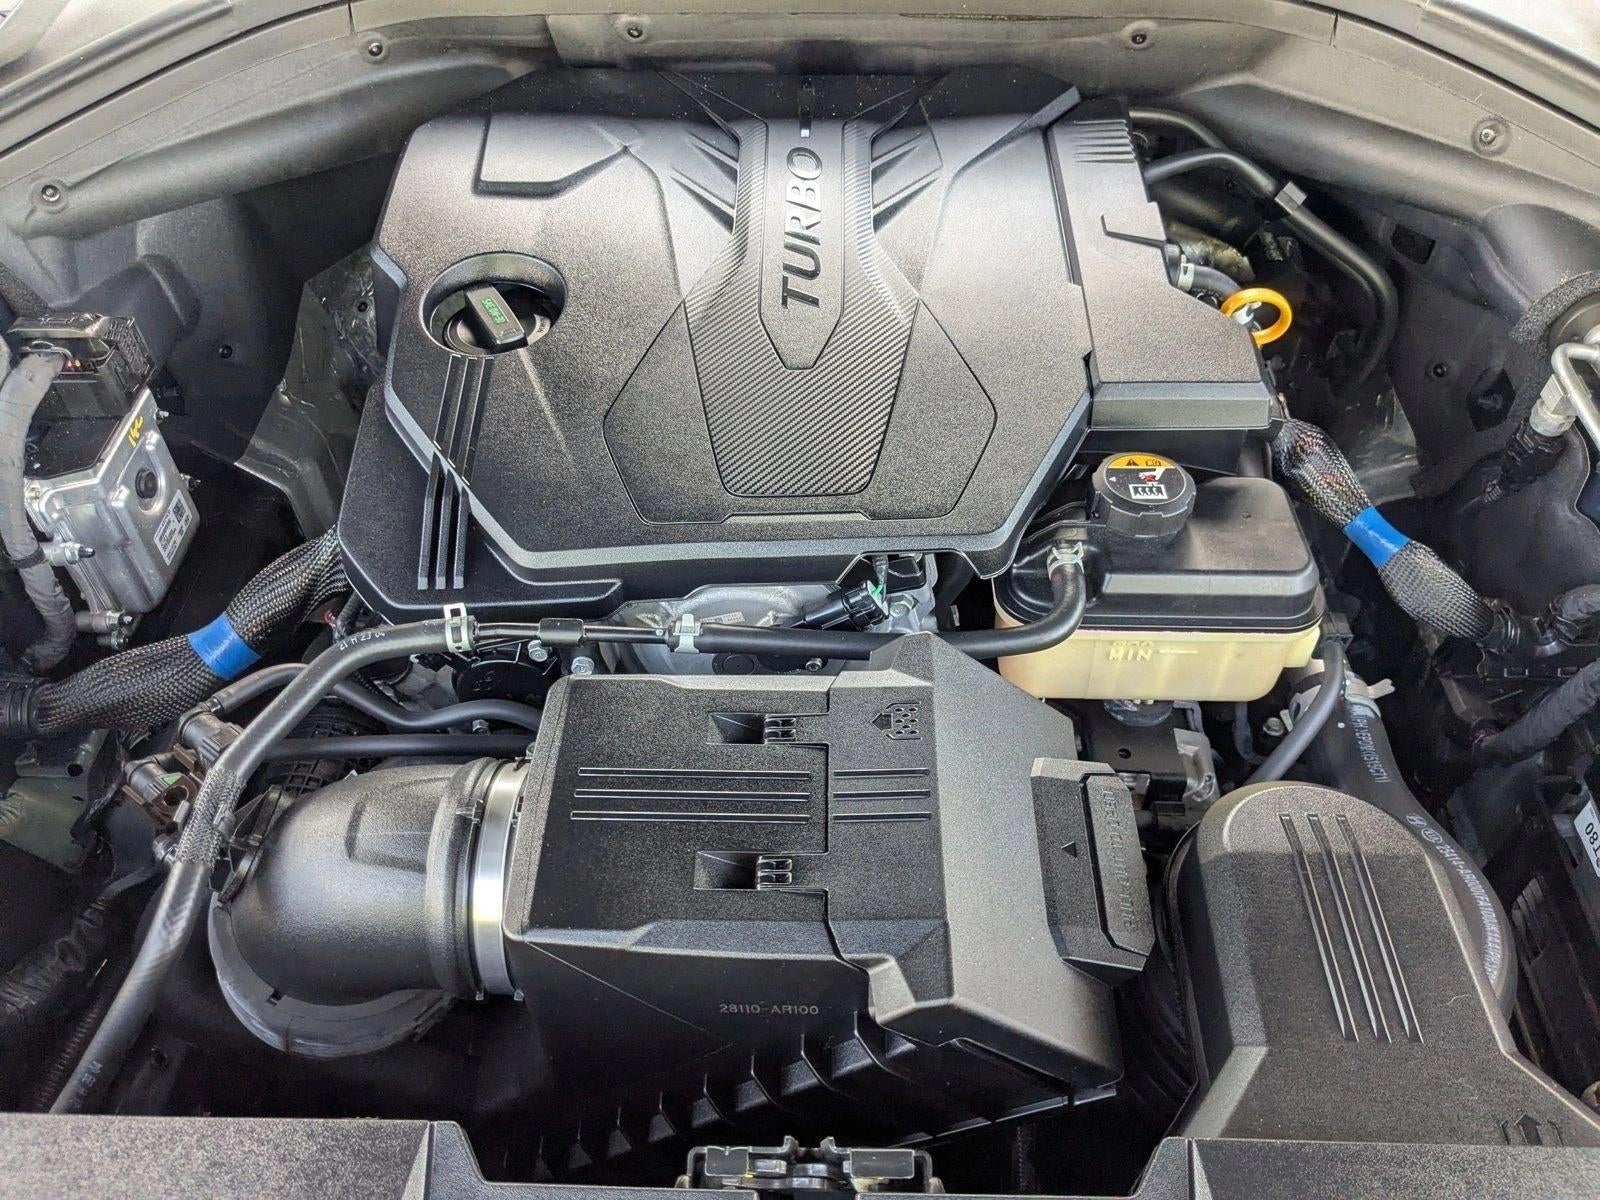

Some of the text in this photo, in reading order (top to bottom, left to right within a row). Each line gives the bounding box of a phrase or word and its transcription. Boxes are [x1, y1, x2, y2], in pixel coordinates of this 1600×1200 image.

[782, 147, 823, 310] TURBO
[1109, 647, 1153, 662] MIN
[719, 1003, 819, 1015] 28110-AR100
